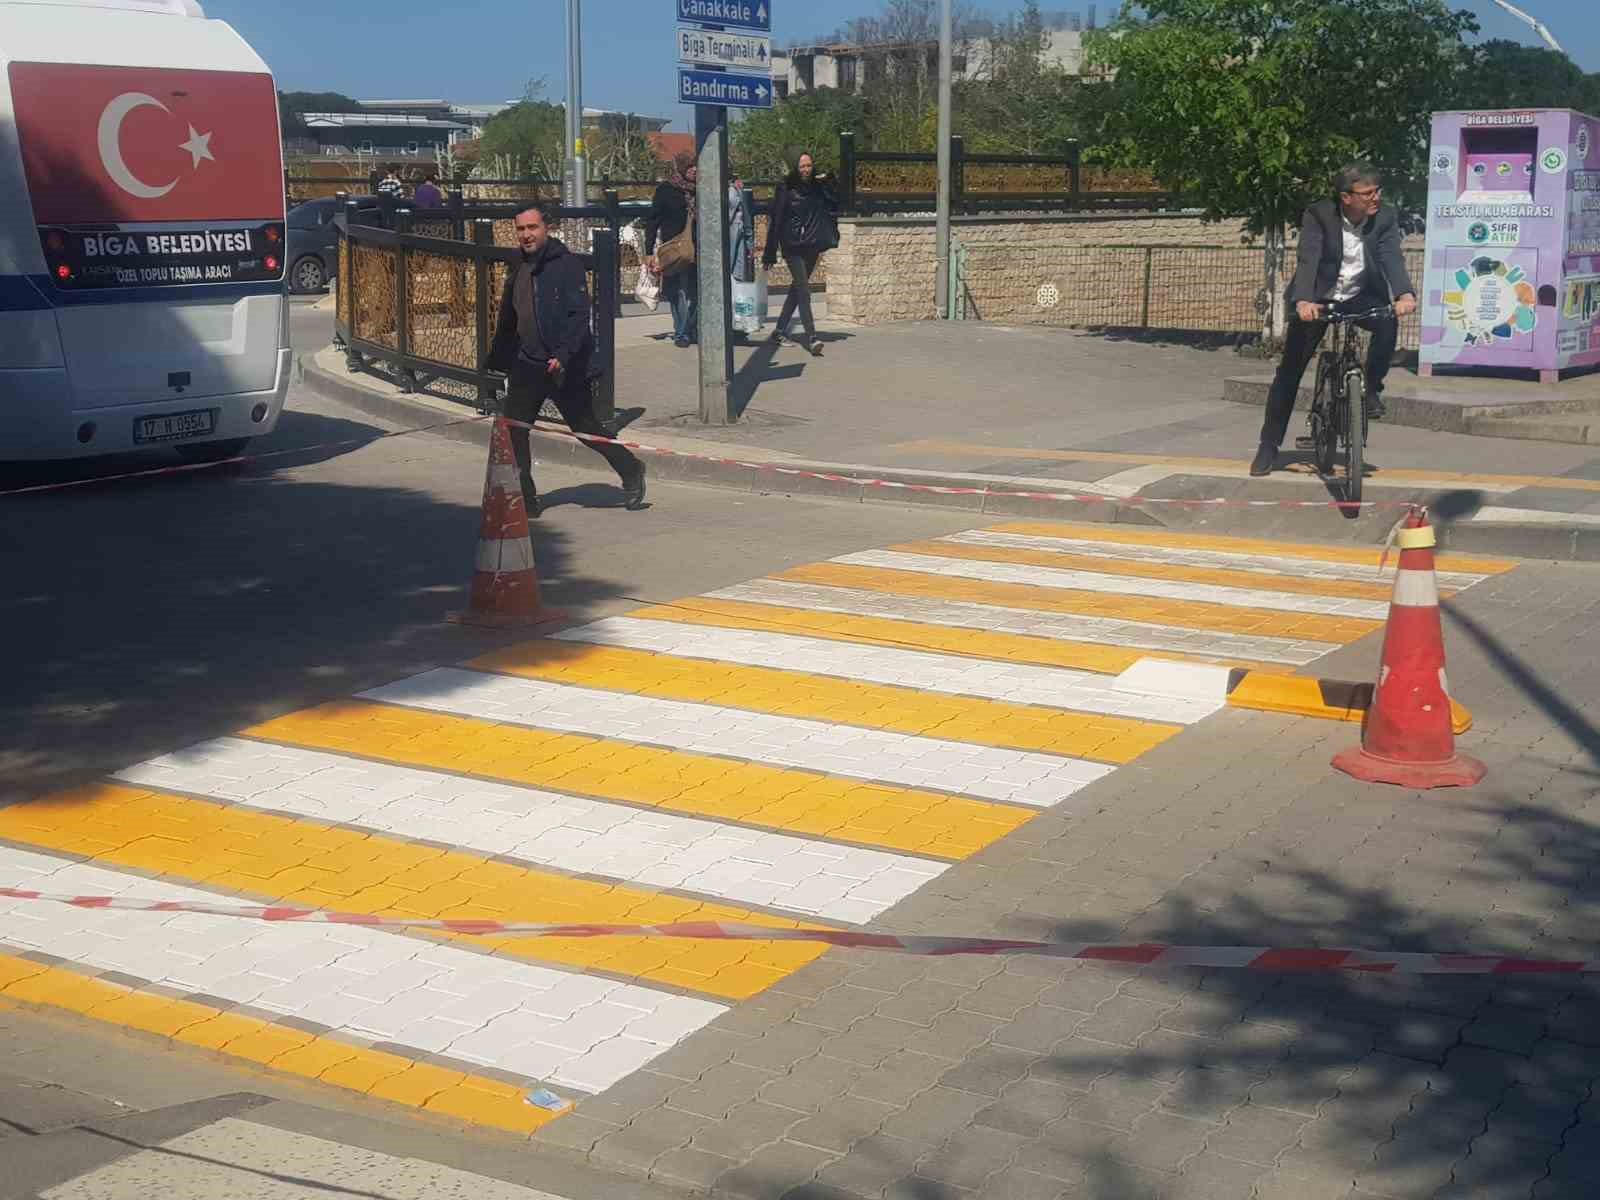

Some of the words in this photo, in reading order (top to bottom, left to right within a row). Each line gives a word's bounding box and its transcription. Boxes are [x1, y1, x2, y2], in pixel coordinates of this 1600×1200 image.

[681, 0, 751, 20] Çanakkale
[682, 34, 705, 57] Biga
[707, 36, 754, 59] Terminali
[682, 76, 748, 99] Bandırma
[1484, 205, 1553, 217] KUMBARASI
[83, 234, 140, 256] BİGA
[146, 229, 252, 254] BELEDİYESİ
[1491, 233, 1517, 242] ATIK
[140, 266, 168, 281] TOPLU
[169, 265, 202, 283] TAŞIMA
[205, 264, 232, 279] ARACI
